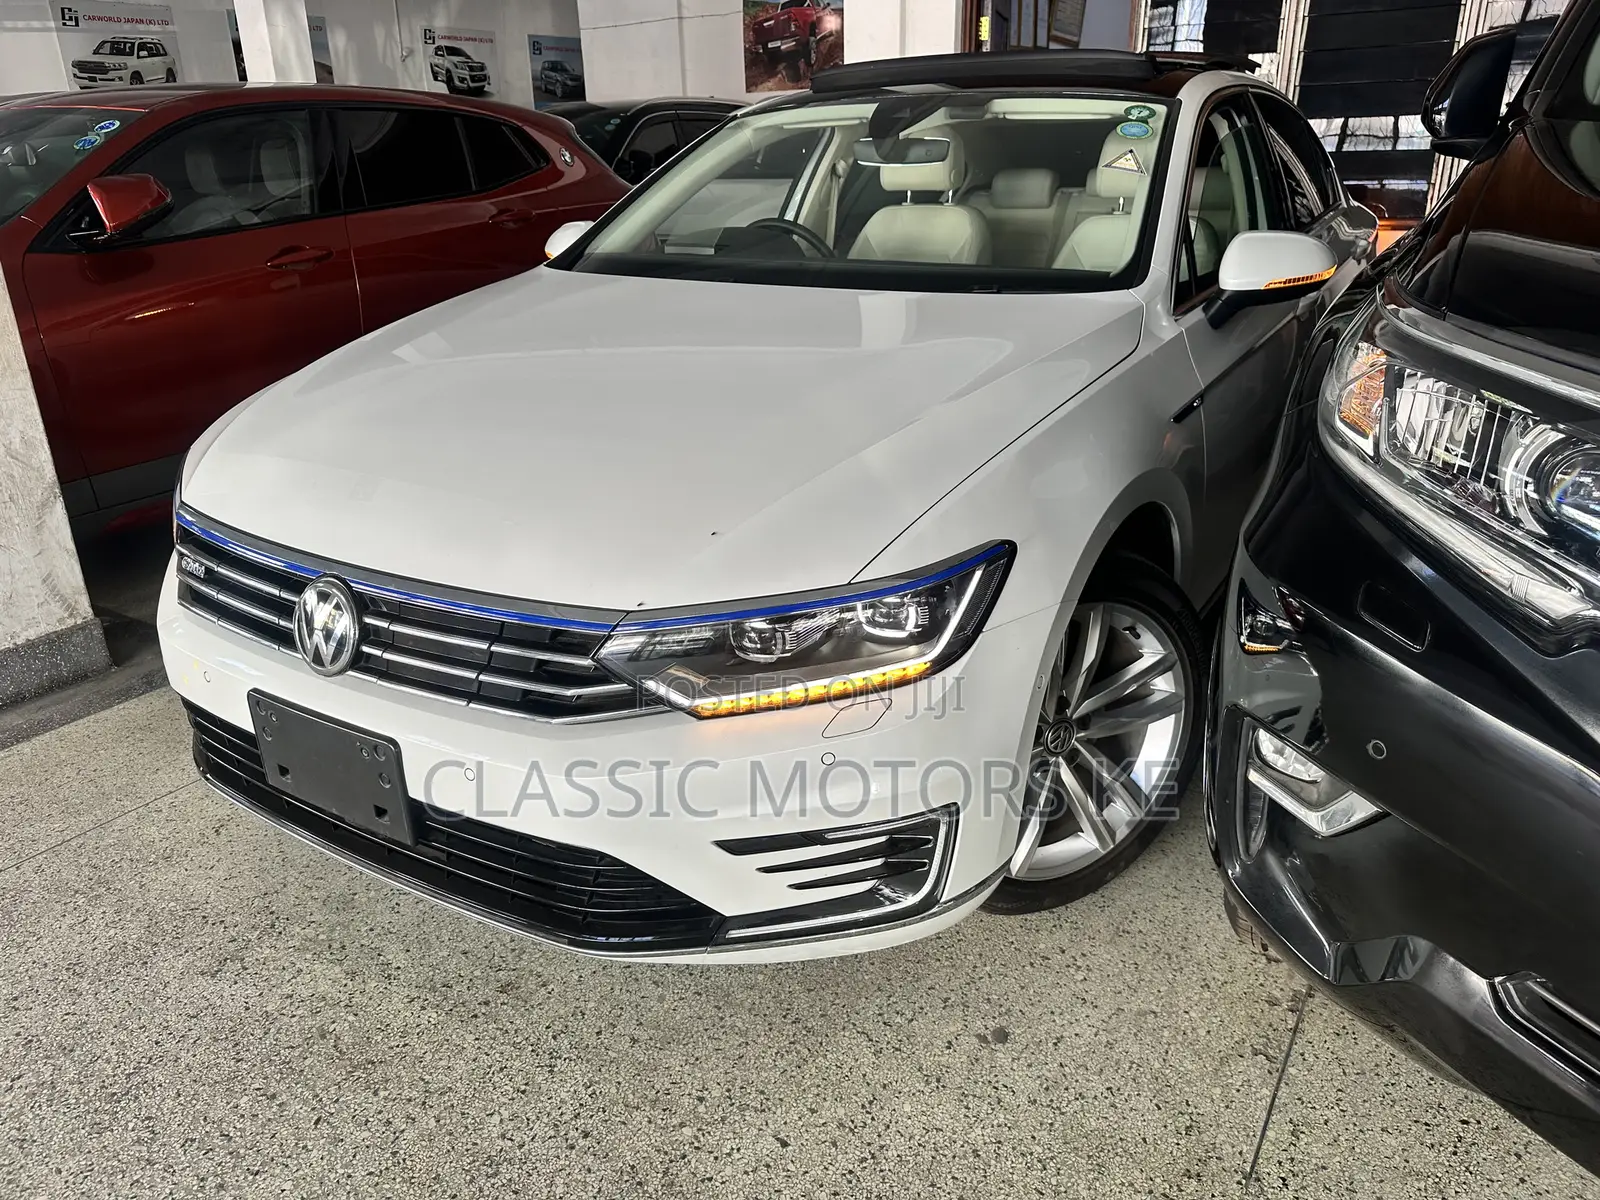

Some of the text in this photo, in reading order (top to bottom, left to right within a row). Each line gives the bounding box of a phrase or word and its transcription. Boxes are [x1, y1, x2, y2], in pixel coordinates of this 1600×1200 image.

[82, 14, 122, 23] CARWORLD
[123, 17, 144, 25] JAPAN
[145, 18, 156, 26] (K)
